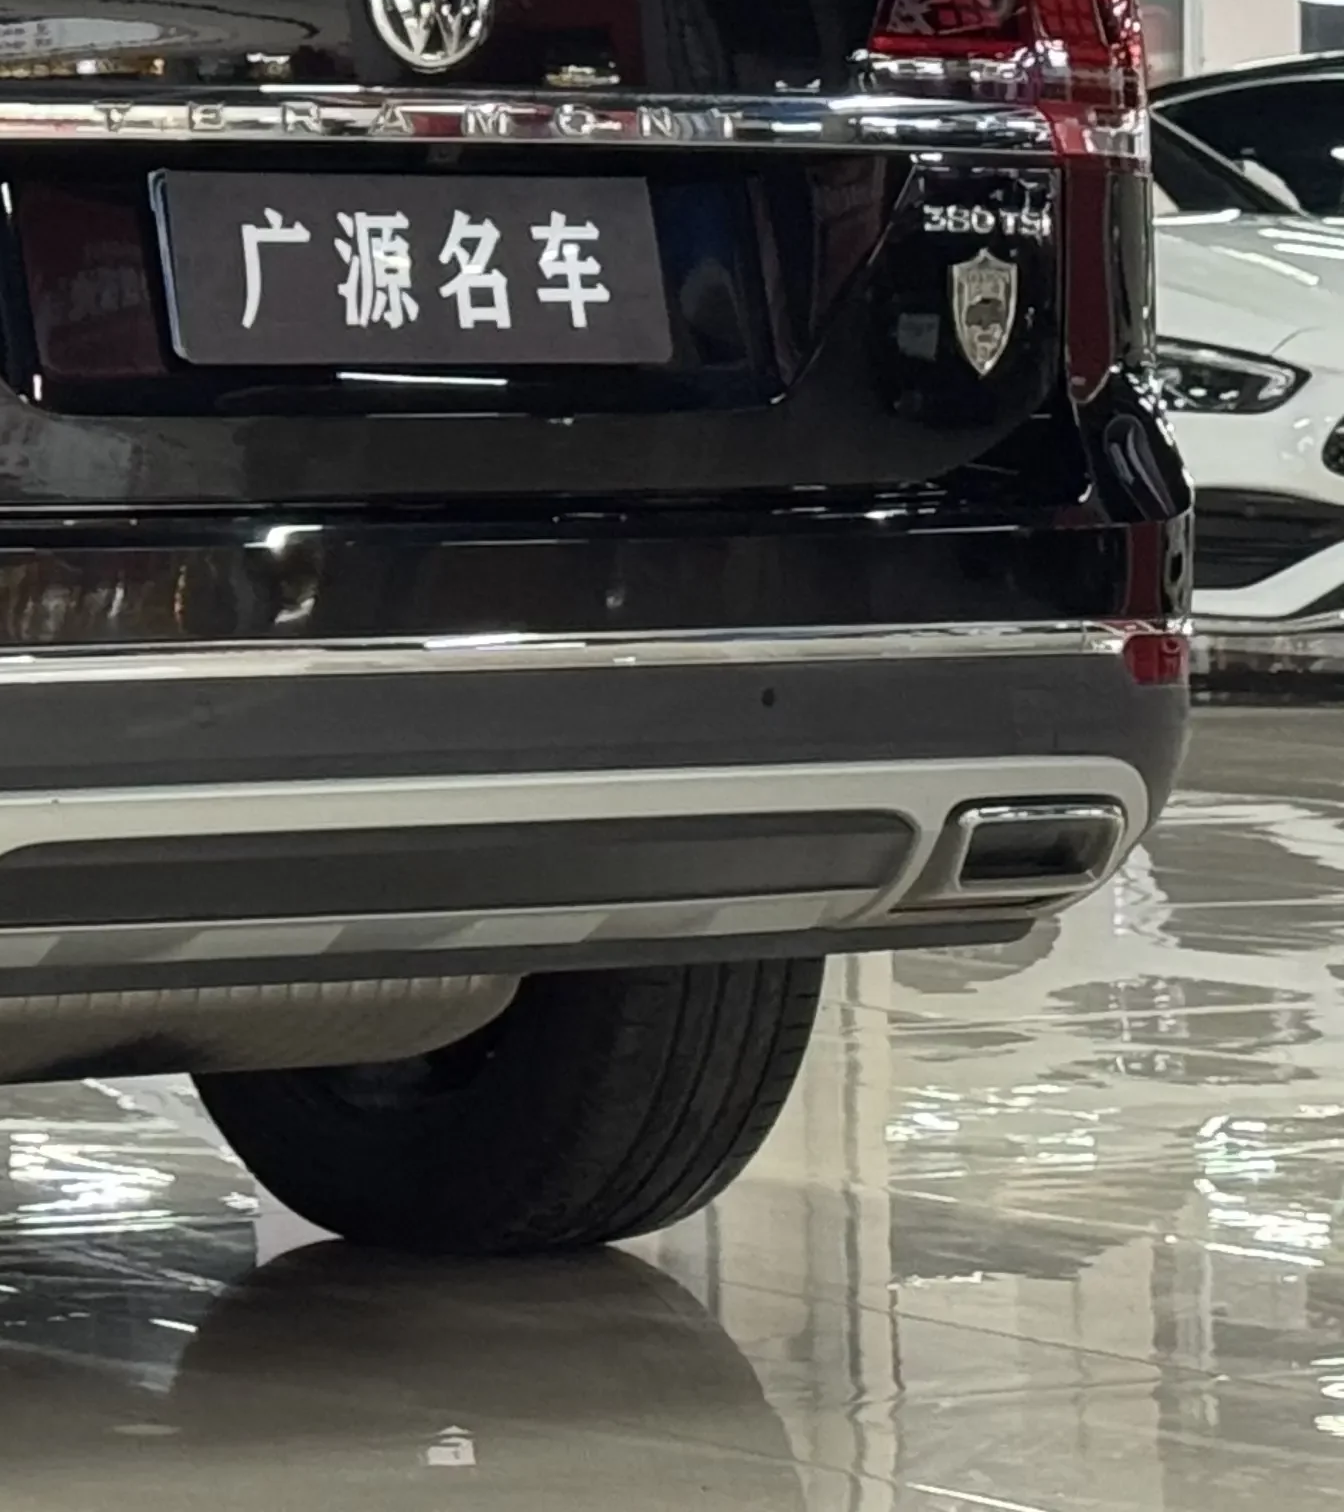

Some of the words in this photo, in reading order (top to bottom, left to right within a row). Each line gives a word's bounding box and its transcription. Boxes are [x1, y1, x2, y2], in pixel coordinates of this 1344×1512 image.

[93, 100, 743, 138] TERAMONT
[922, 203, 996, 235] 380
[998, 205, 1052, 238] TSI
[238, 206, 611, 331] 广源名车
